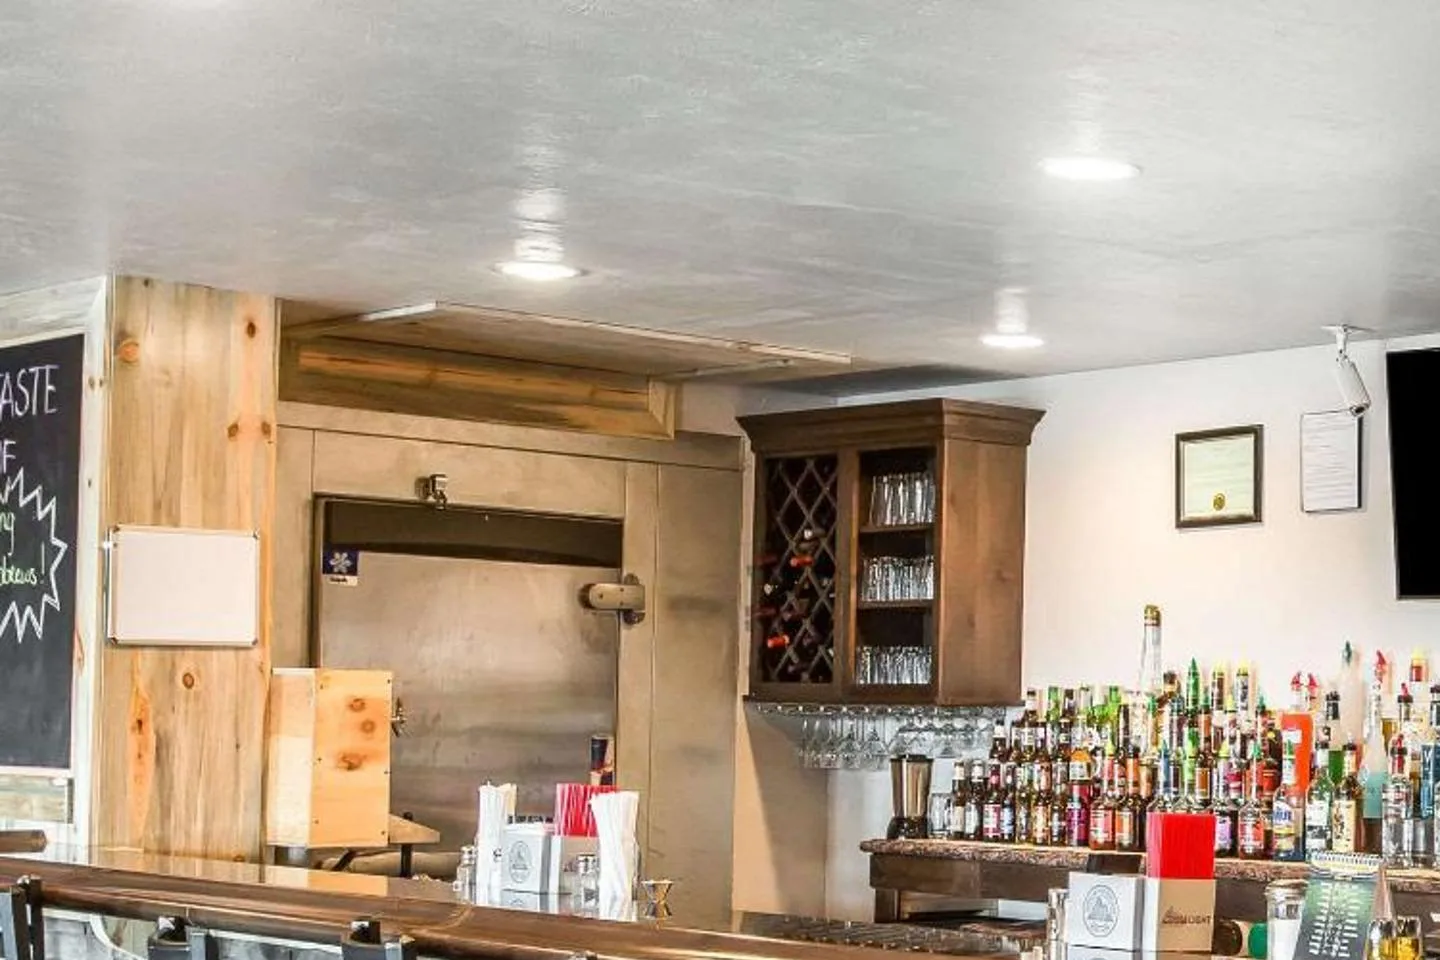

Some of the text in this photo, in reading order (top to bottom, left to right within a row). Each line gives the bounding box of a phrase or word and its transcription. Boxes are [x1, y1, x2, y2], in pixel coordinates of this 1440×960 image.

[0, 364, 60, 419] ASTE
[0, 439, 16, 473] F
[0, 541, 45, 585] brews!
